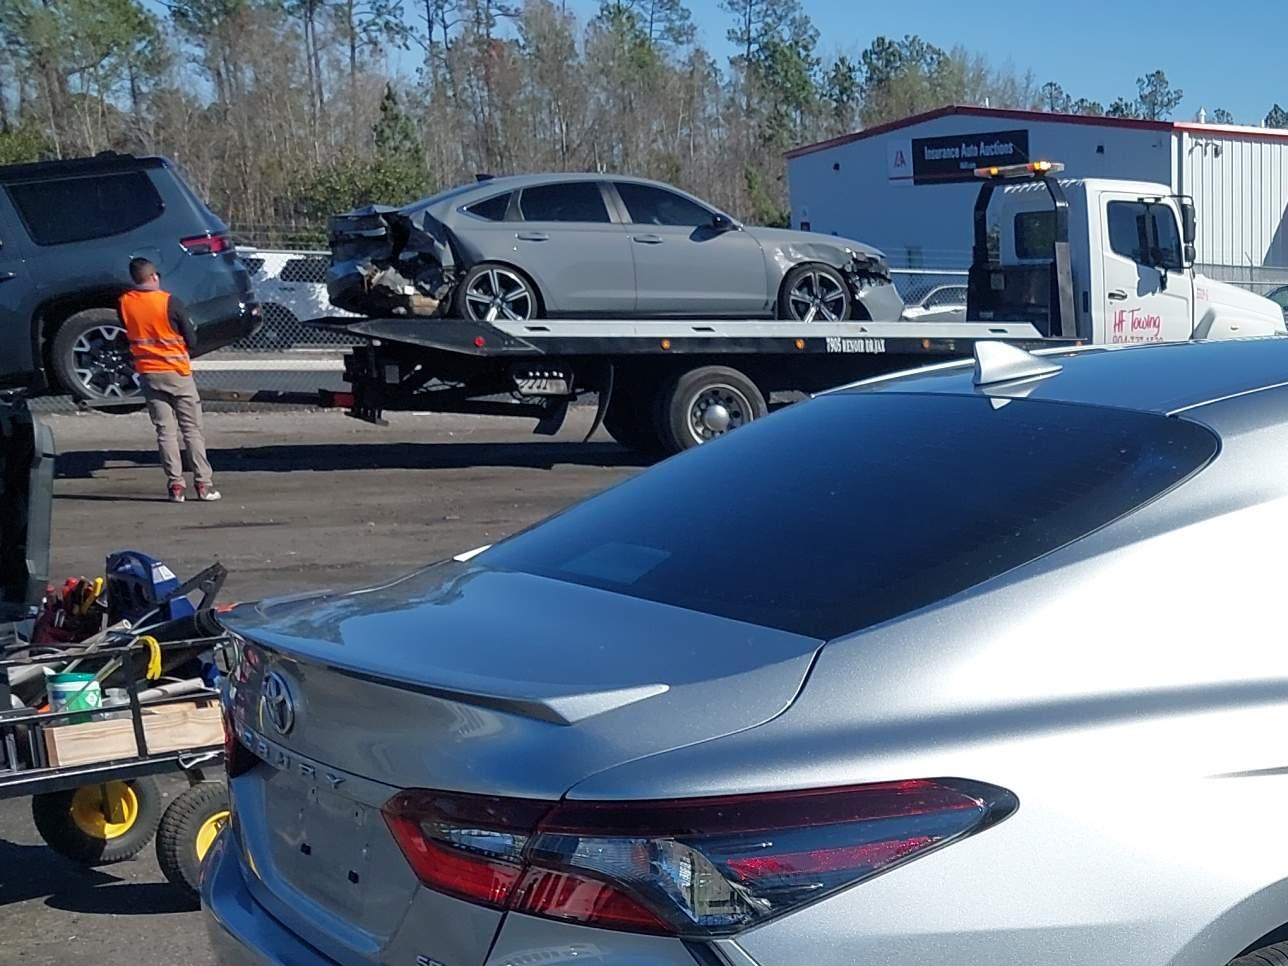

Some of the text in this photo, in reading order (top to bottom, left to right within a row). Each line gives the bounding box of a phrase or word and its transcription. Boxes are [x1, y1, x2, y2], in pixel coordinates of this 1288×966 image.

[924, 140, 1014, 160] Insurance Auto Auctions
[1113, 308, 1161, 336] HF Towing
